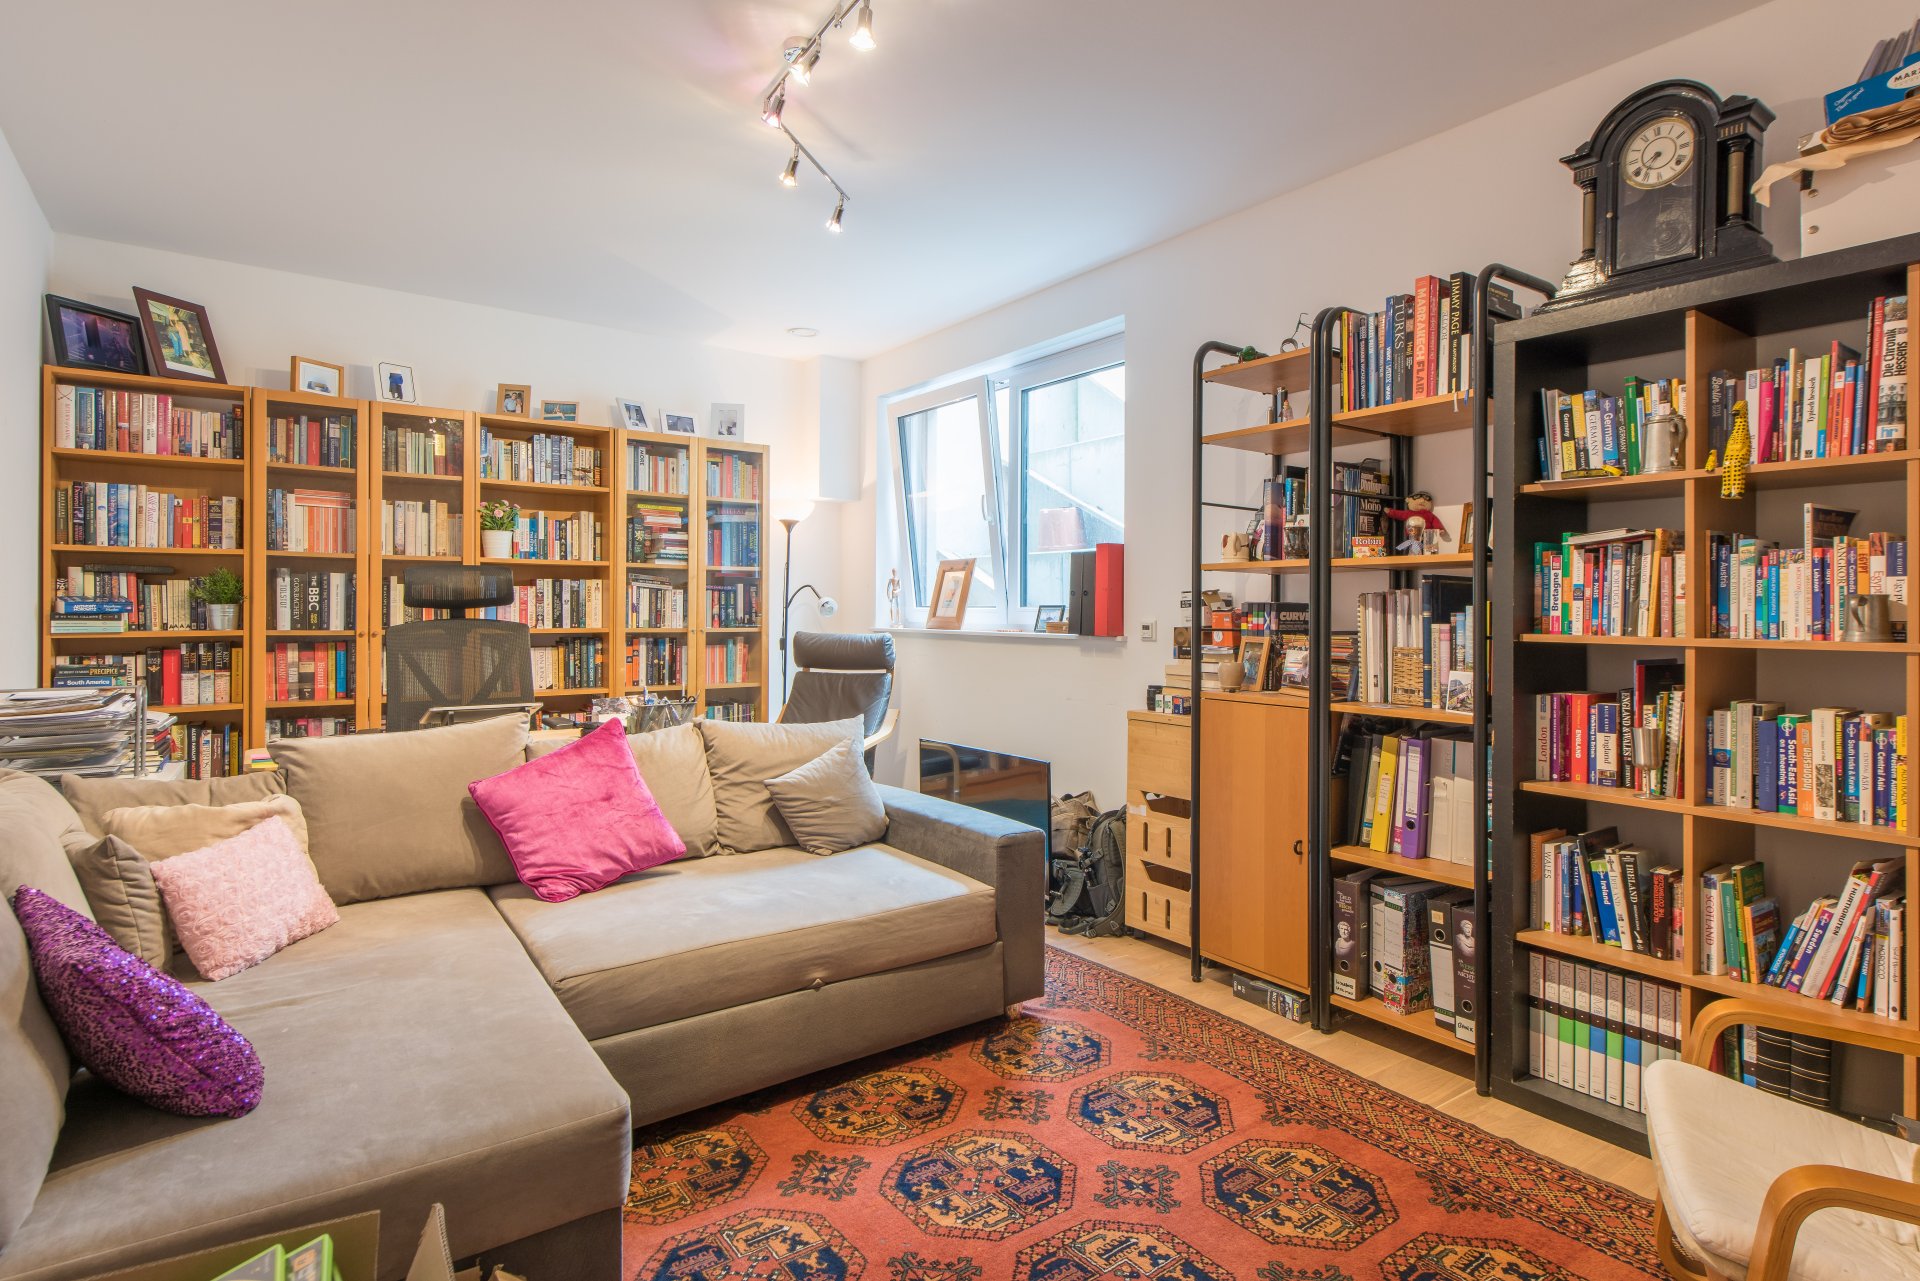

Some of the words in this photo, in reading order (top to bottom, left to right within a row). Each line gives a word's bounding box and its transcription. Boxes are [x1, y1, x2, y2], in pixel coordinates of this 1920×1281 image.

[1894, 68, 1920, 82] MAR
[1450, 278, 1461, 309] JIMMY
[1394, 300, 1405, 350] TURKS
[1416, 287, 1427, 361] MARRAKECH
[1450, 311, 1460, 336] PAGE
[1884, 328, 1897, 362] Chronik
[1895, 341, 1908, 376] Hessens
[1415, 361, 1425, 395] FLAIR
[1882, 363, 1894, 377] Die
[1711, 376, 1723, 403] Berlin
[1562, 413, 1570, 437] Germany
[1588, 414, 1599, 457] GERMANY
[1603, 413, 1614, 451] Germany
[1355, 537, 1382, 546] Robin
[1719, 562, 1729, 588] Austria
[1837, 544, 1847, 585] ANGKOR
[1858, 553, 1868, 574] EGYPT
[1552, 572, 1561, 611] Bretagne
[1848, 565, 1856, 593] Cambodia
[1870, 570, 1885, 594] Egypt
[1893, 579, 1906, 604] Egypt
[308, 587, 319, 611] BBC
[86, 679, 110, 687] America
[1621, 692, 1631, 726] ENGLAND
[1538, 727, 1548, 763] London
[1602, 735, 1611, 764] England
[1623, 733, 1632, 757] WALES
[1779, 739, 1785, 748] on
[1848, 739, 1856, 756] South
[1778, 753, 1787, 786] shoestring
[1787, 739, 1797, 785] South-East
[1801, 747, 1812, 792] Indonesien
[1848, 756, 1856, 769] India
[1877, 751, 1886, 776] Central
[1788, 787, 1797, 805] Asia
[1848, 776, 1856, 794] Kerala
[1861, 774, 1870, 792] ASIA
[1877, 777, 1886, 791] Asia
[1543, 851, 1552, 879] WALES
[1600, 880, 1610, 905] Ireland
[1609, 875, 1621, 907] IRELAND
[1625, 864, 1638, 903] IRELAND
[1705, 894, 1715, 946] SCOTLAND
[1832, 886, 1858, 936] HURTIGRUTEN
[1805, 928, 1823, 954] Sweden
